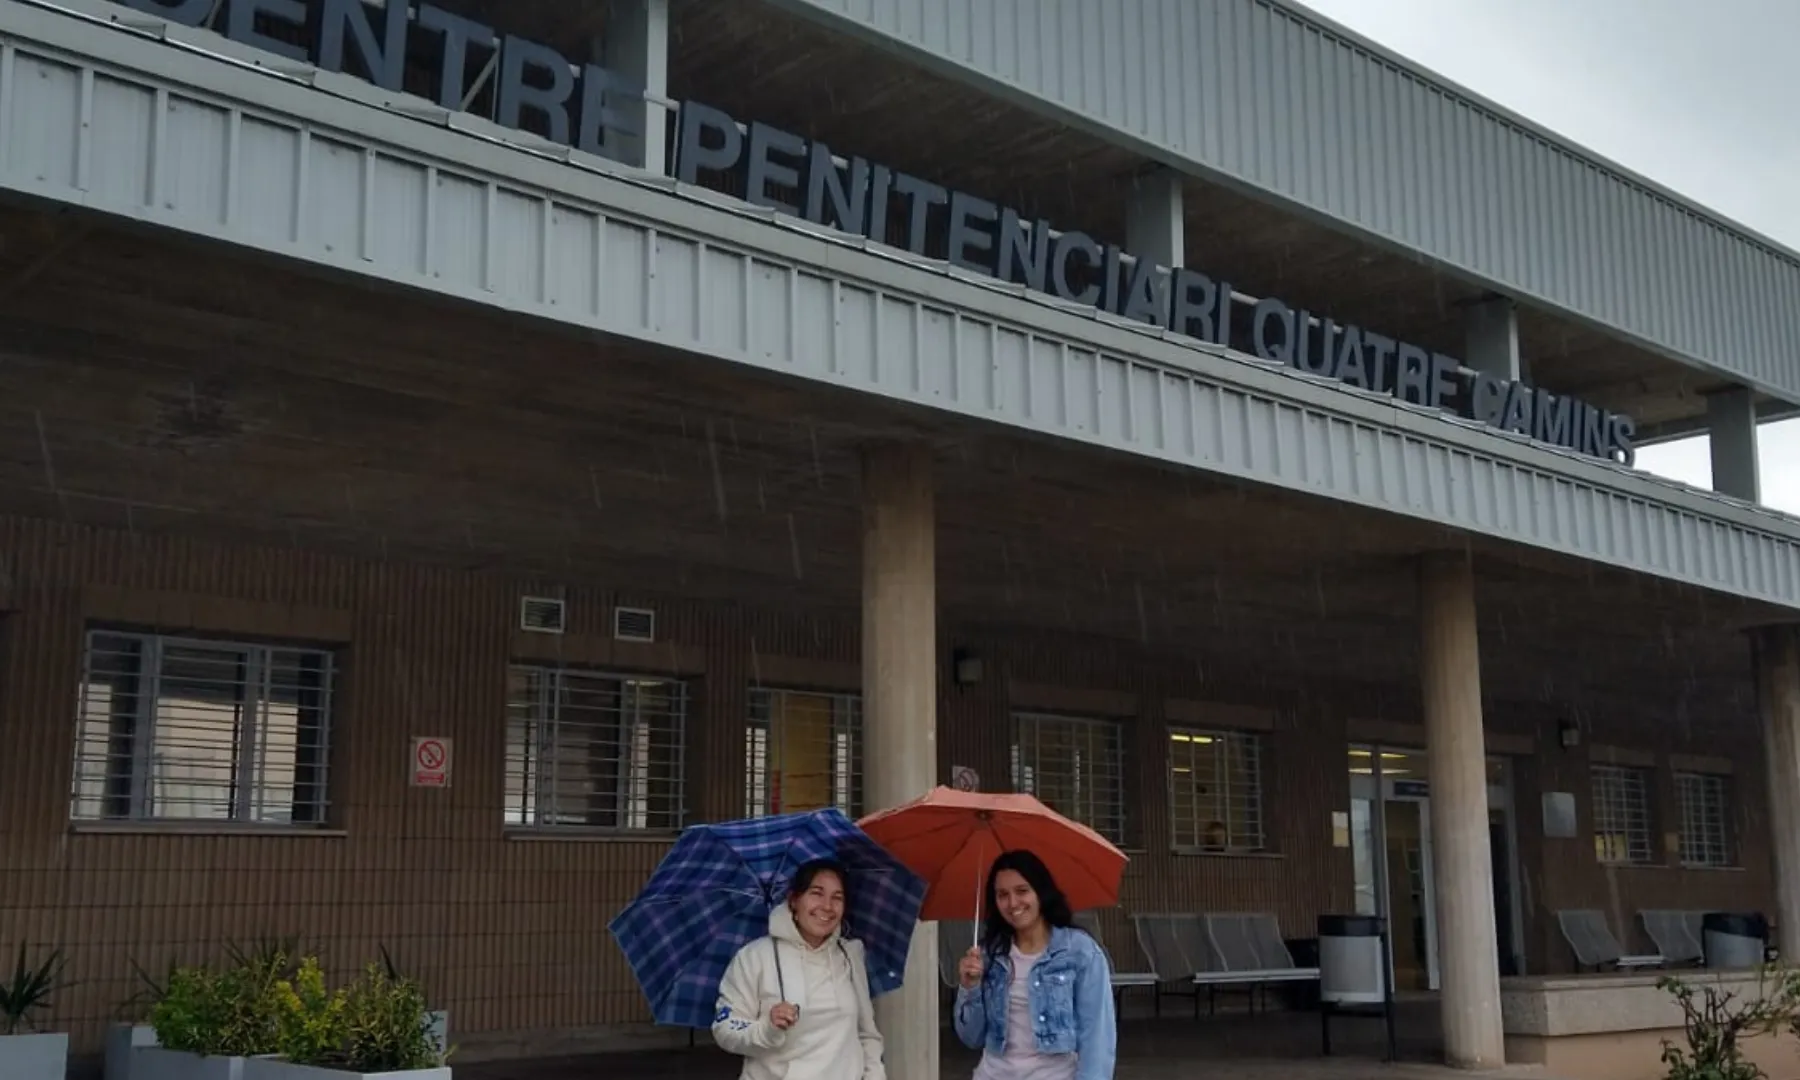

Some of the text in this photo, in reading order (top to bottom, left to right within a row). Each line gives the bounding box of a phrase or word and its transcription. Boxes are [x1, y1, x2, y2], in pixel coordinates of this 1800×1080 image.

[120, 0, 1636, 468] ENTRE PENITENCIARI QUATRE CAMINS
